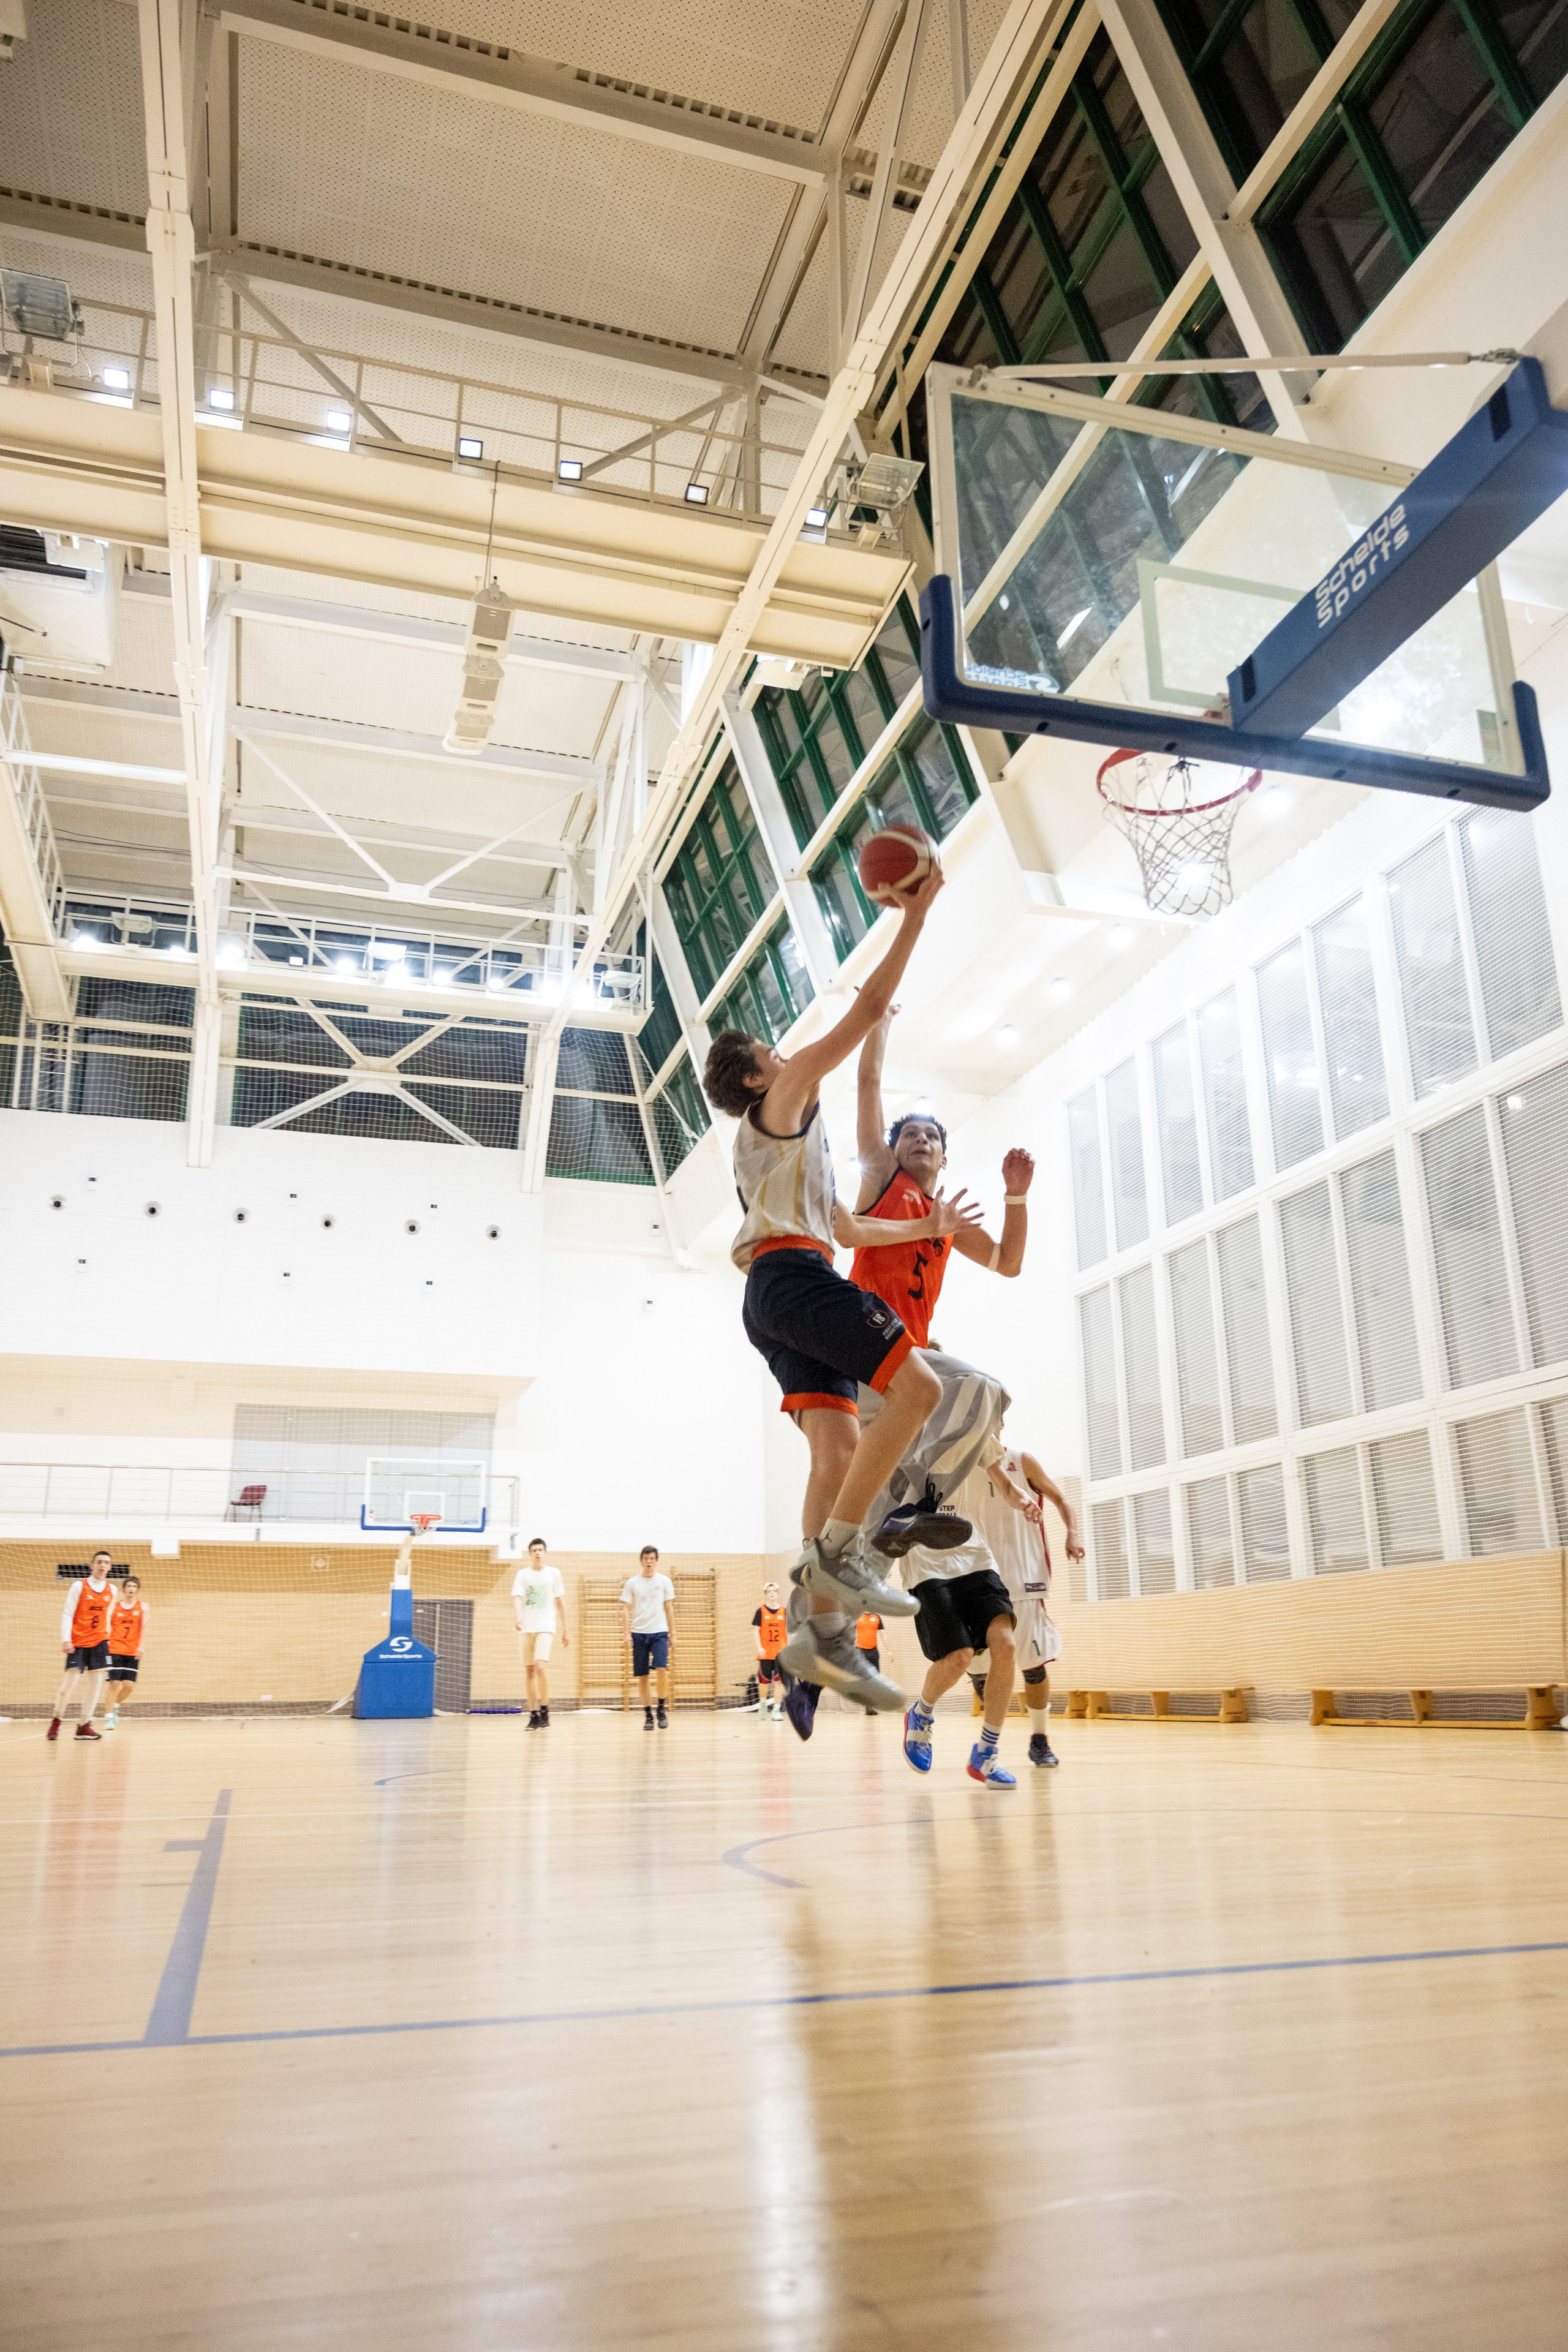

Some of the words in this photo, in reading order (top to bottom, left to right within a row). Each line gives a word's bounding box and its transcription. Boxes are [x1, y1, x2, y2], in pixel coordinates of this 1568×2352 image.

[908, 1251, 929, 1299] 5
[769, 1630, 779, 1642] 12
[1032, 1640, 1041, 1656] 1
